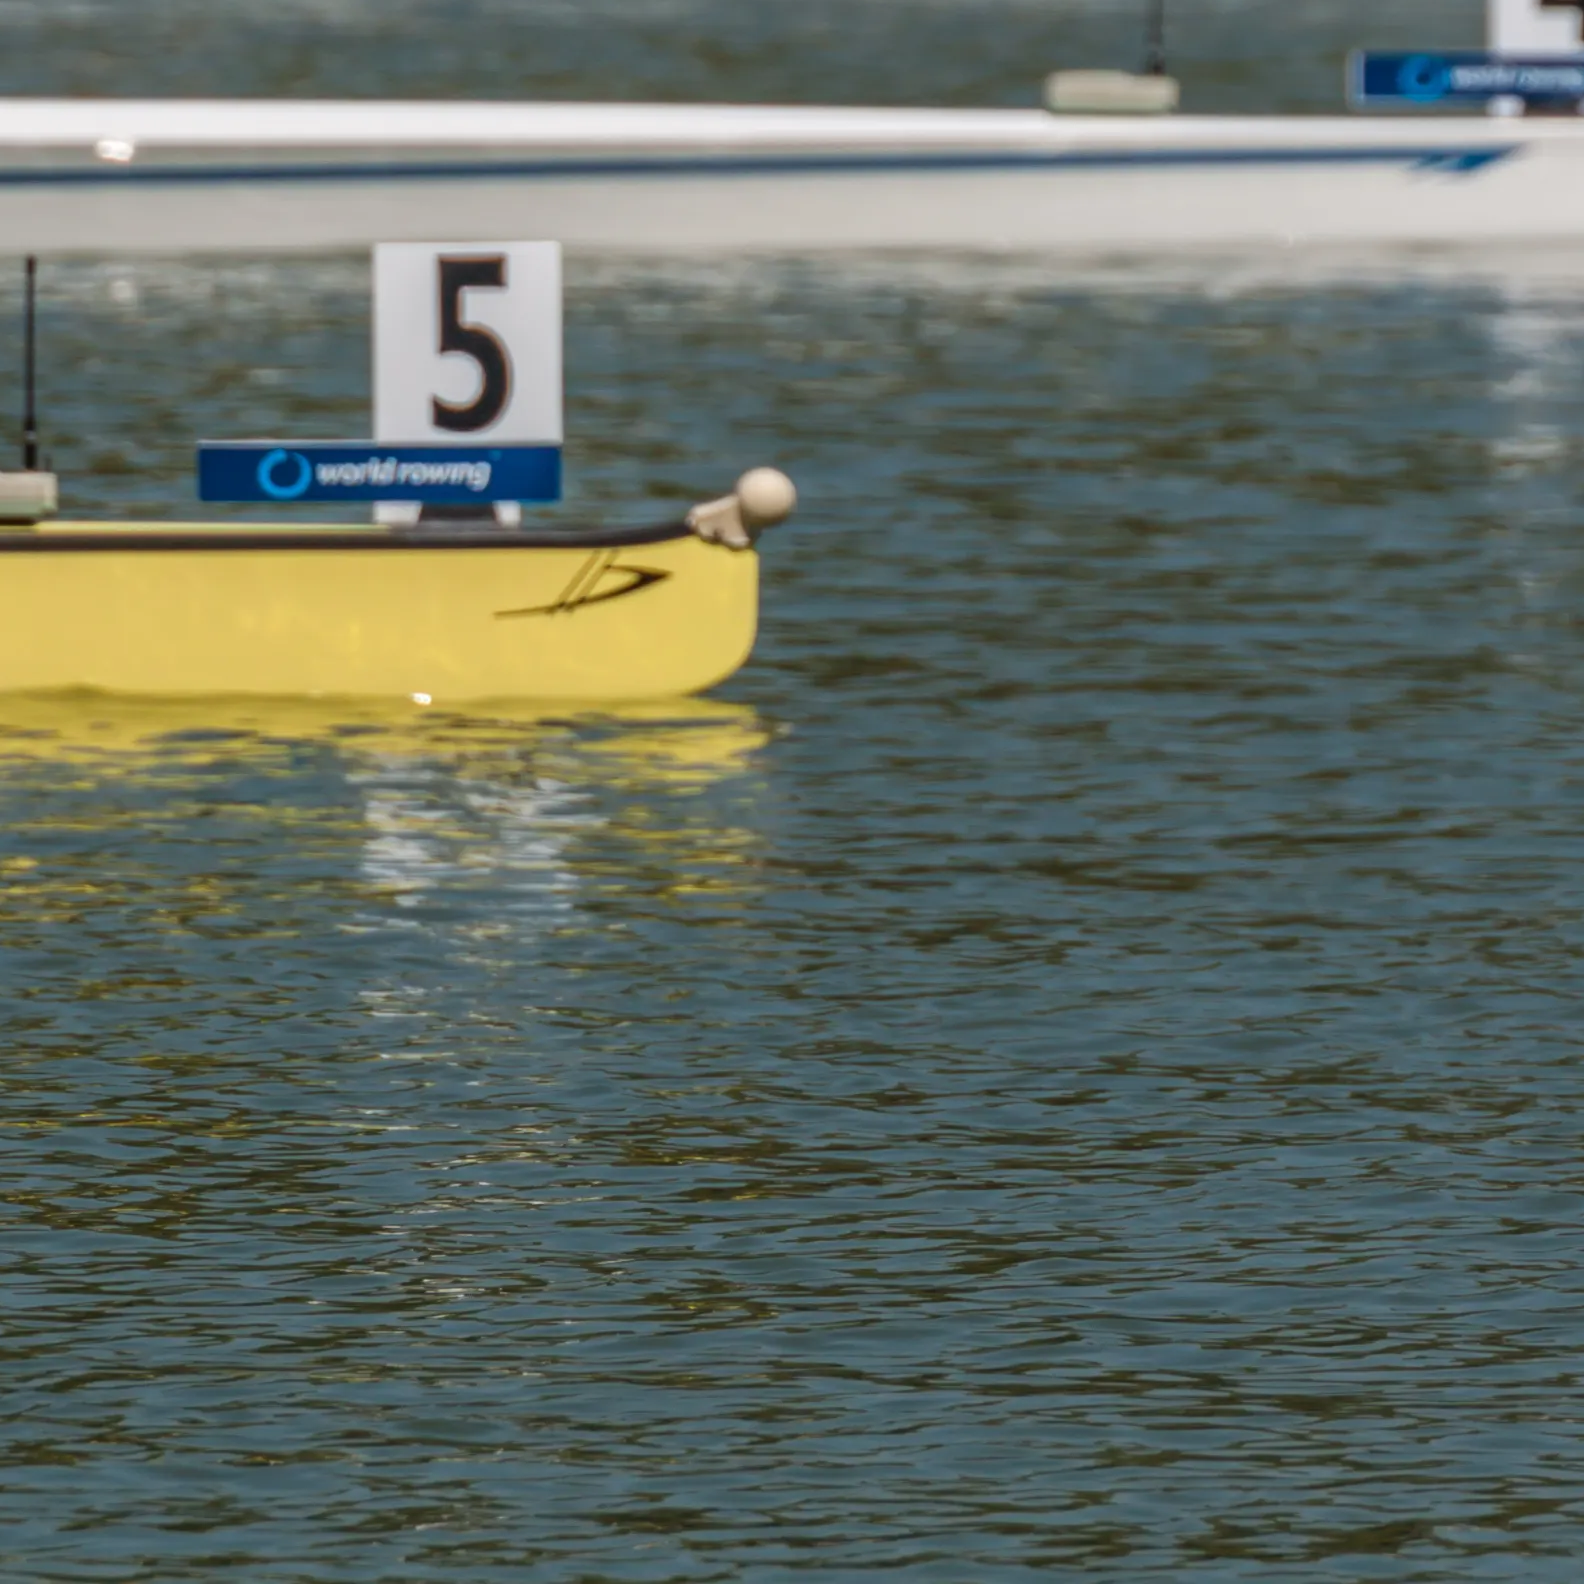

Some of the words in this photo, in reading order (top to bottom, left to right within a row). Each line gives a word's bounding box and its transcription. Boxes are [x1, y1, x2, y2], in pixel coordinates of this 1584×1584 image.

[431, 252, 513, 432] 5
[316, 456, 397, 486] world
[397, 461, 492, 493] rowing
